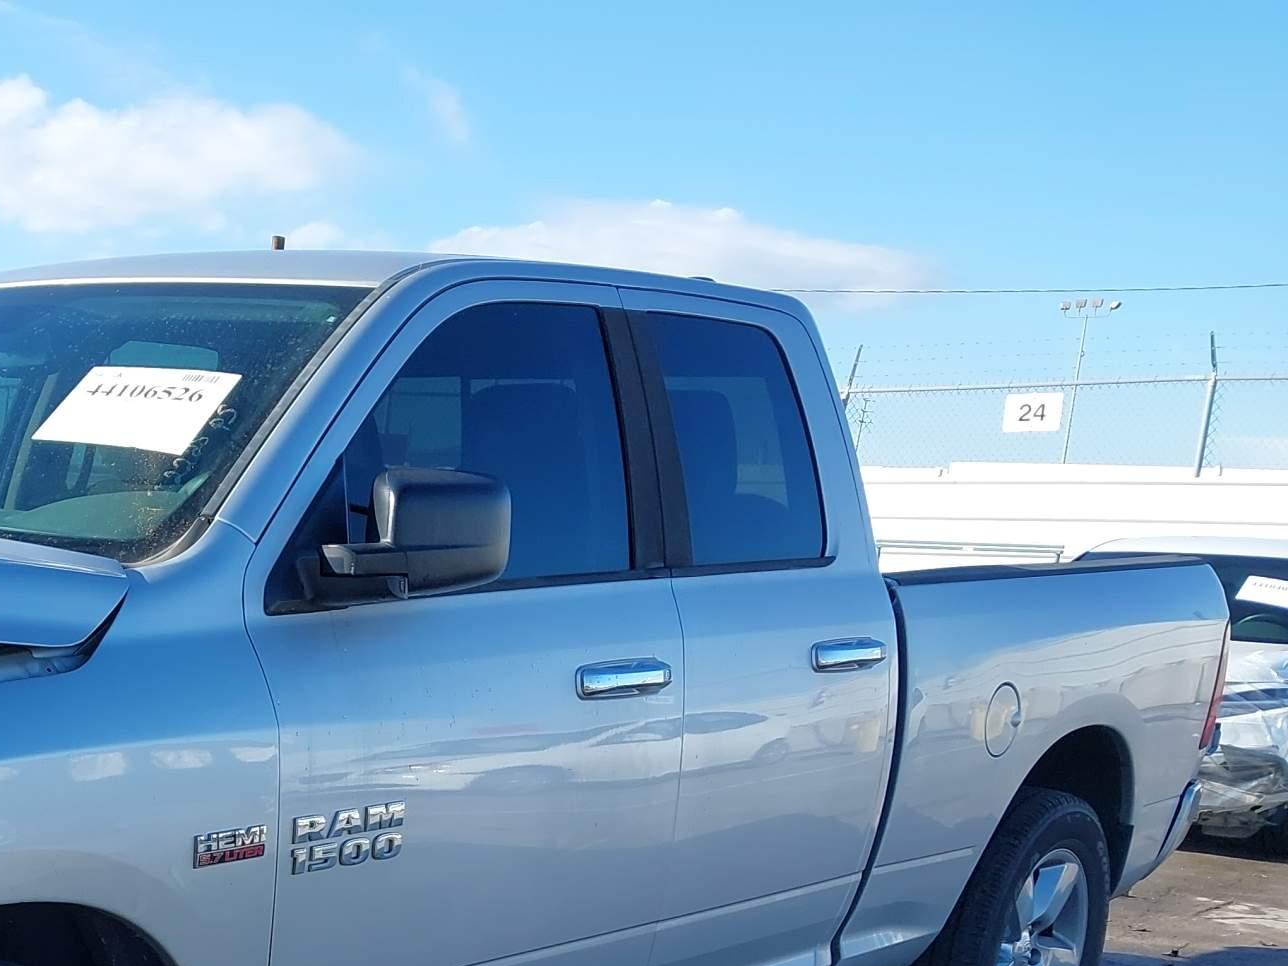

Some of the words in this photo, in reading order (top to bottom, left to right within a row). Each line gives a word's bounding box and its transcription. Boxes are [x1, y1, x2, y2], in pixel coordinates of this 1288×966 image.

[86, 383, 205, 402] 44106526
[1017, 403, 1047, 422] 24
[291, 800, 406, 845] RAM
[193, 824, 268, 854] HEMI
[199, 852, 224, 867] 5.7
[290, 831, 404, 876] 1500
